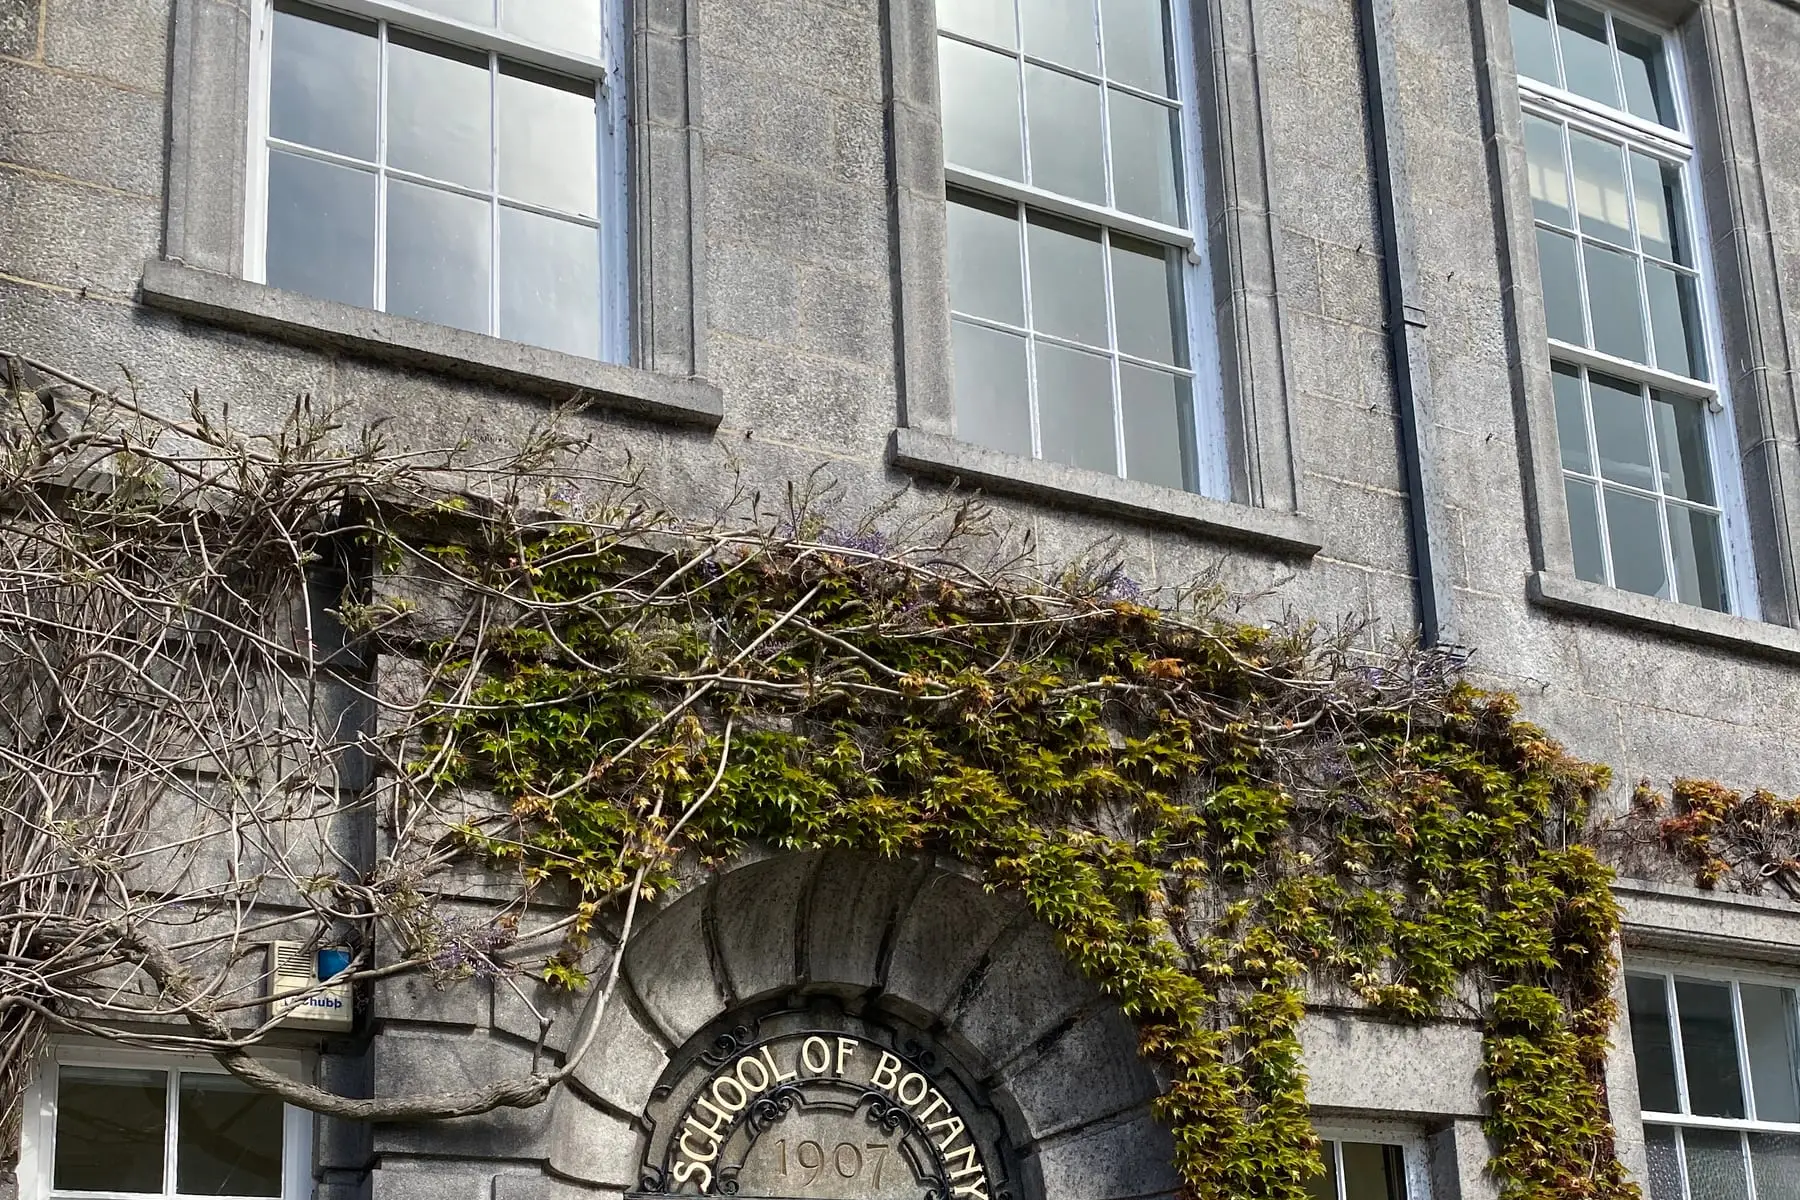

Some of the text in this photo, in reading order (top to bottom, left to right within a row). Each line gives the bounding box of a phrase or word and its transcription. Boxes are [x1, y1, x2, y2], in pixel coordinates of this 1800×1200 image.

[673, 1045, 798, 1192] SCHOOL
[802, 1035, 859, 1074] OF
[775, 1138, 889, 1190] 1907
